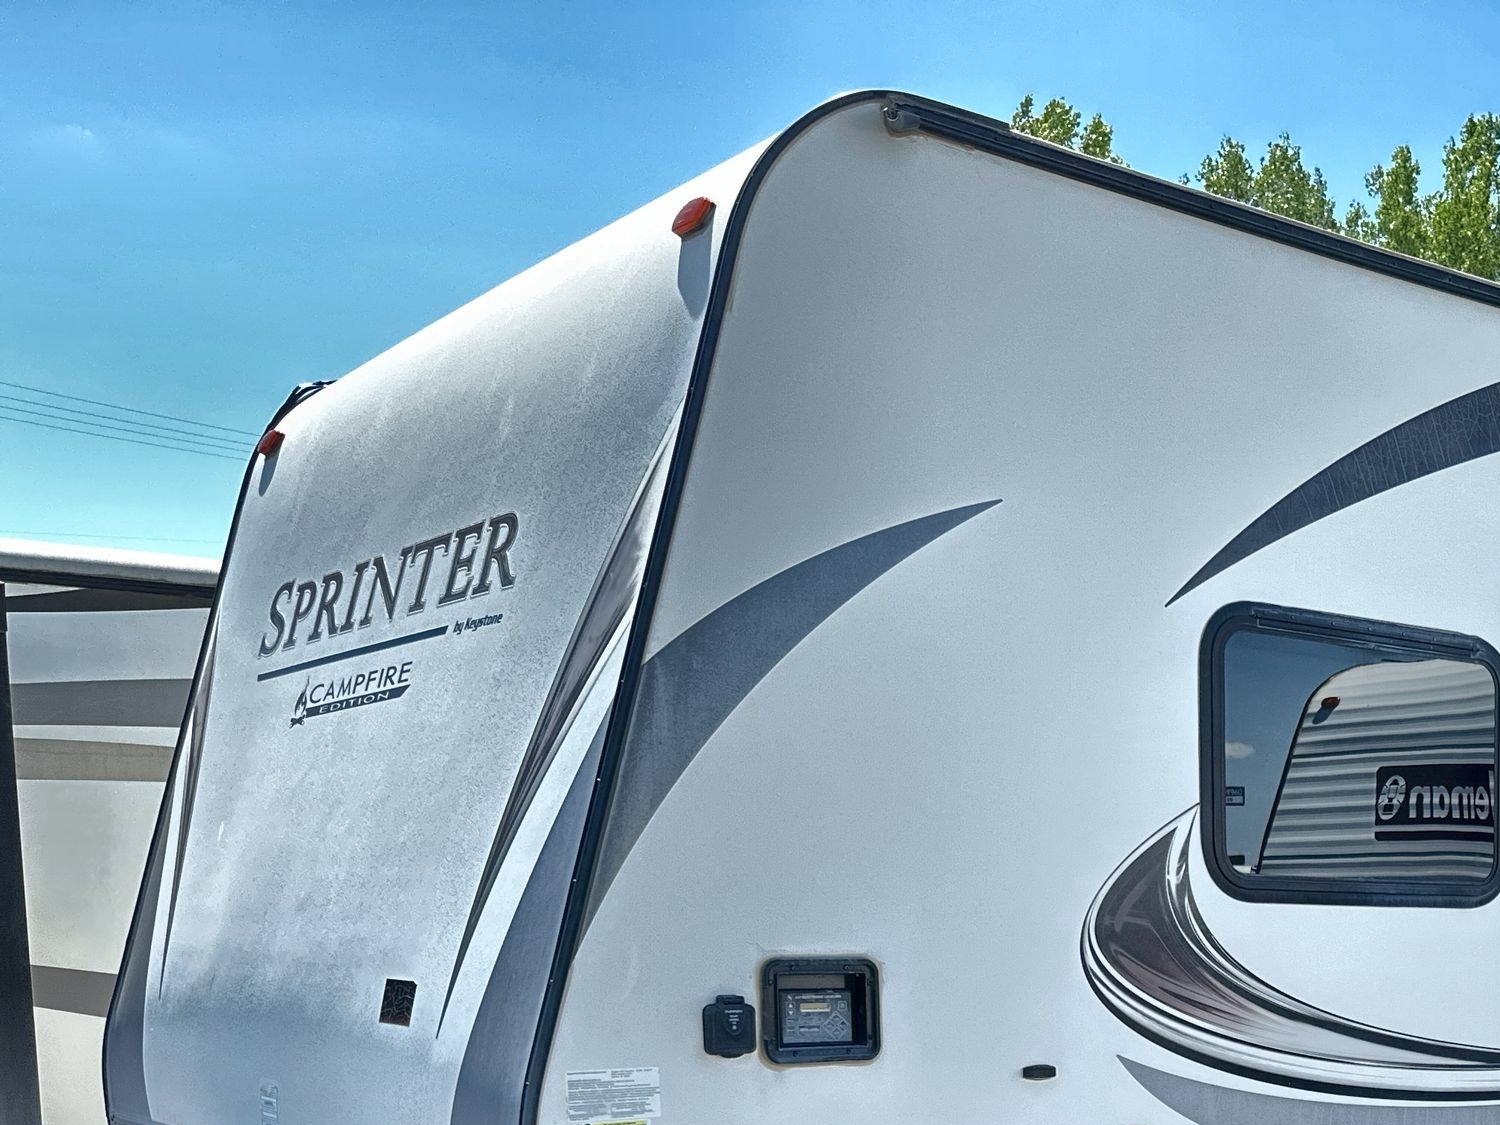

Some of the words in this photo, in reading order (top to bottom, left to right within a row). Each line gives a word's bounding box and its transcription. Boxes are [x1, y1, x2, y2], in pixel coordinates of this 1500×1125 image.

[453, 620, 463, 634] by
[464, 613, 503, 632] Keystone
[309, 661, 414, 704] CAMPFIRE
[319, 691, 390, 713] EDITION
